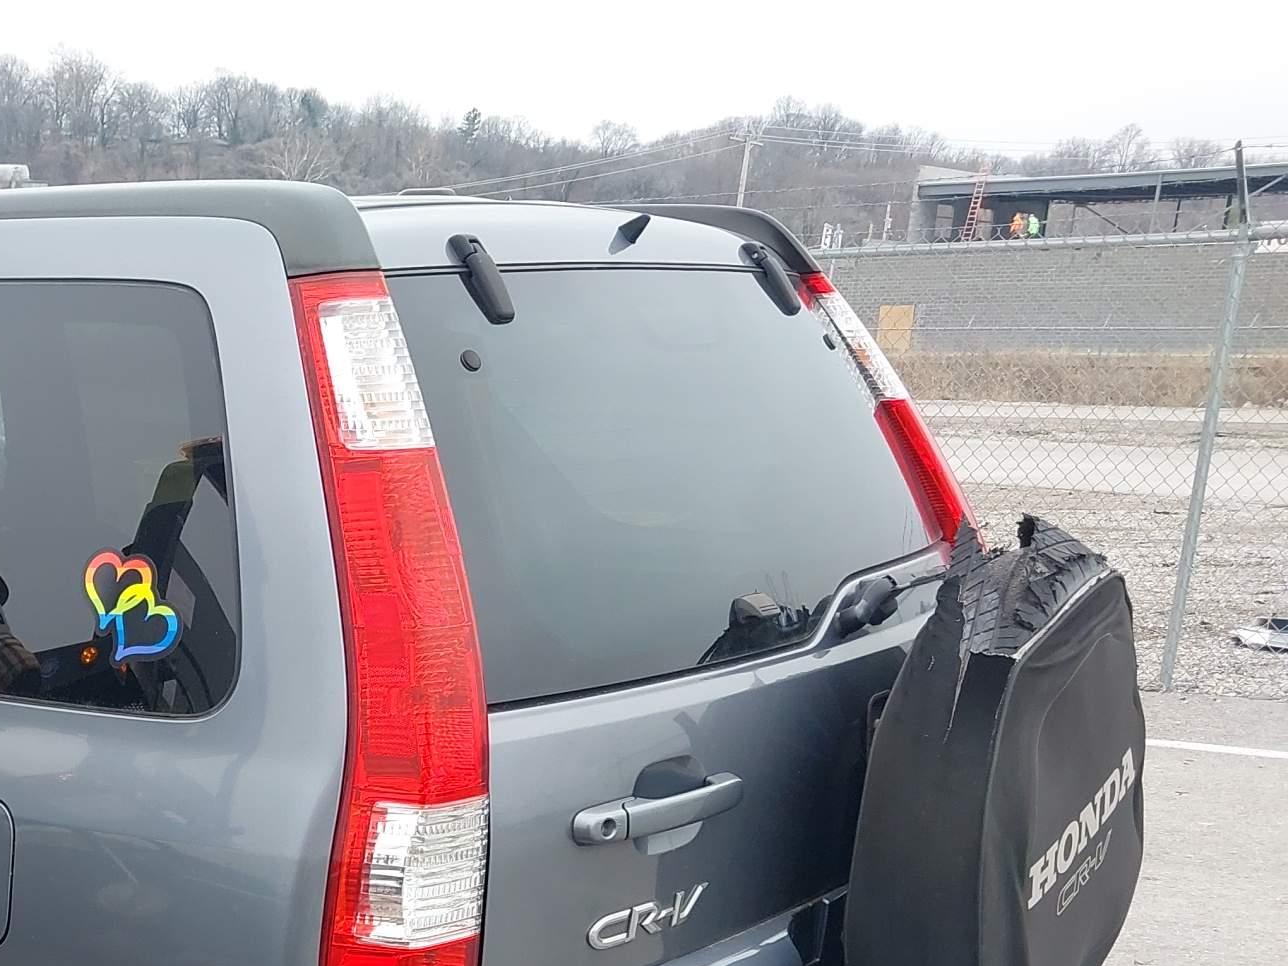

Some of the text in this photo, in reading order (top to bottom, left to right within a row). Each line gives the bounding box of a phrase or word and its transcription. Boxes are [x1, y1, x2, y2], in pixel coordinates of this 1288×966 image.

[1027, 746, 1136, 910] HONDA
[1056, 827, 1113, 917] CR-V
[586, 881, 710, 950] CR-V
